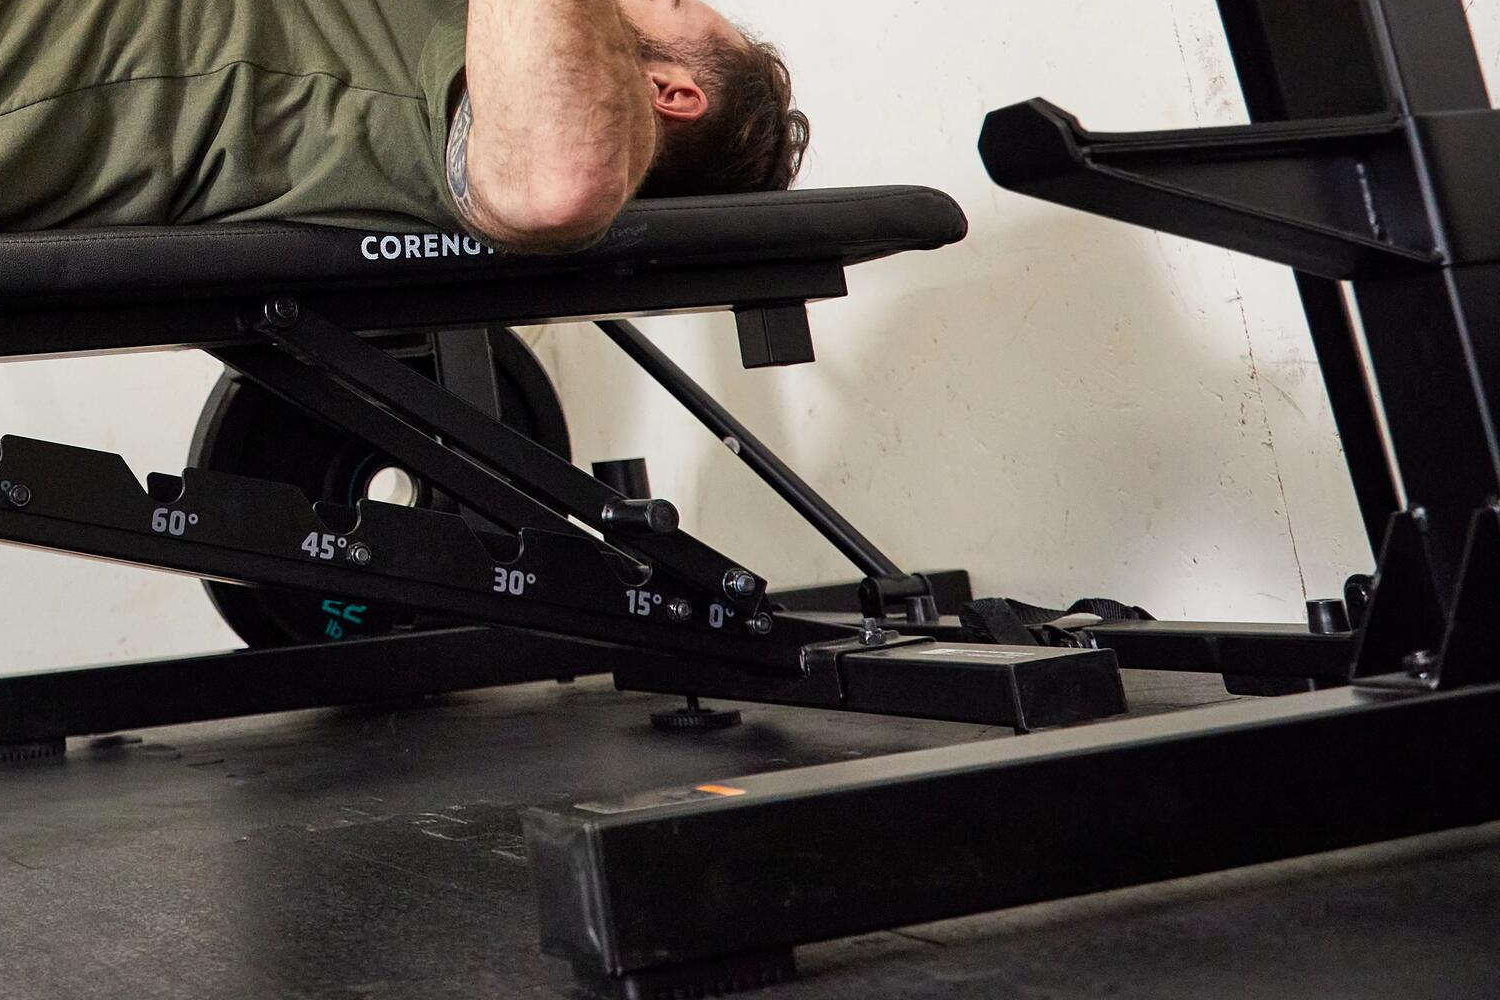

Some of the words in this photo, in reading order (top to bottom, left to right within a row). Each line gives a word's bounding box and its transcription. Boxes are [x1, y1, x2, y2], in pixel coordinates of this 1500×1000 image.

[360, 233, 496, 260] CORENG
[151, 507, 199, 536] 60°
[301, 531, 348, 560] 45°
[493, 567, 537, 596] 30°
[626, 589, 663, 617] 15°
